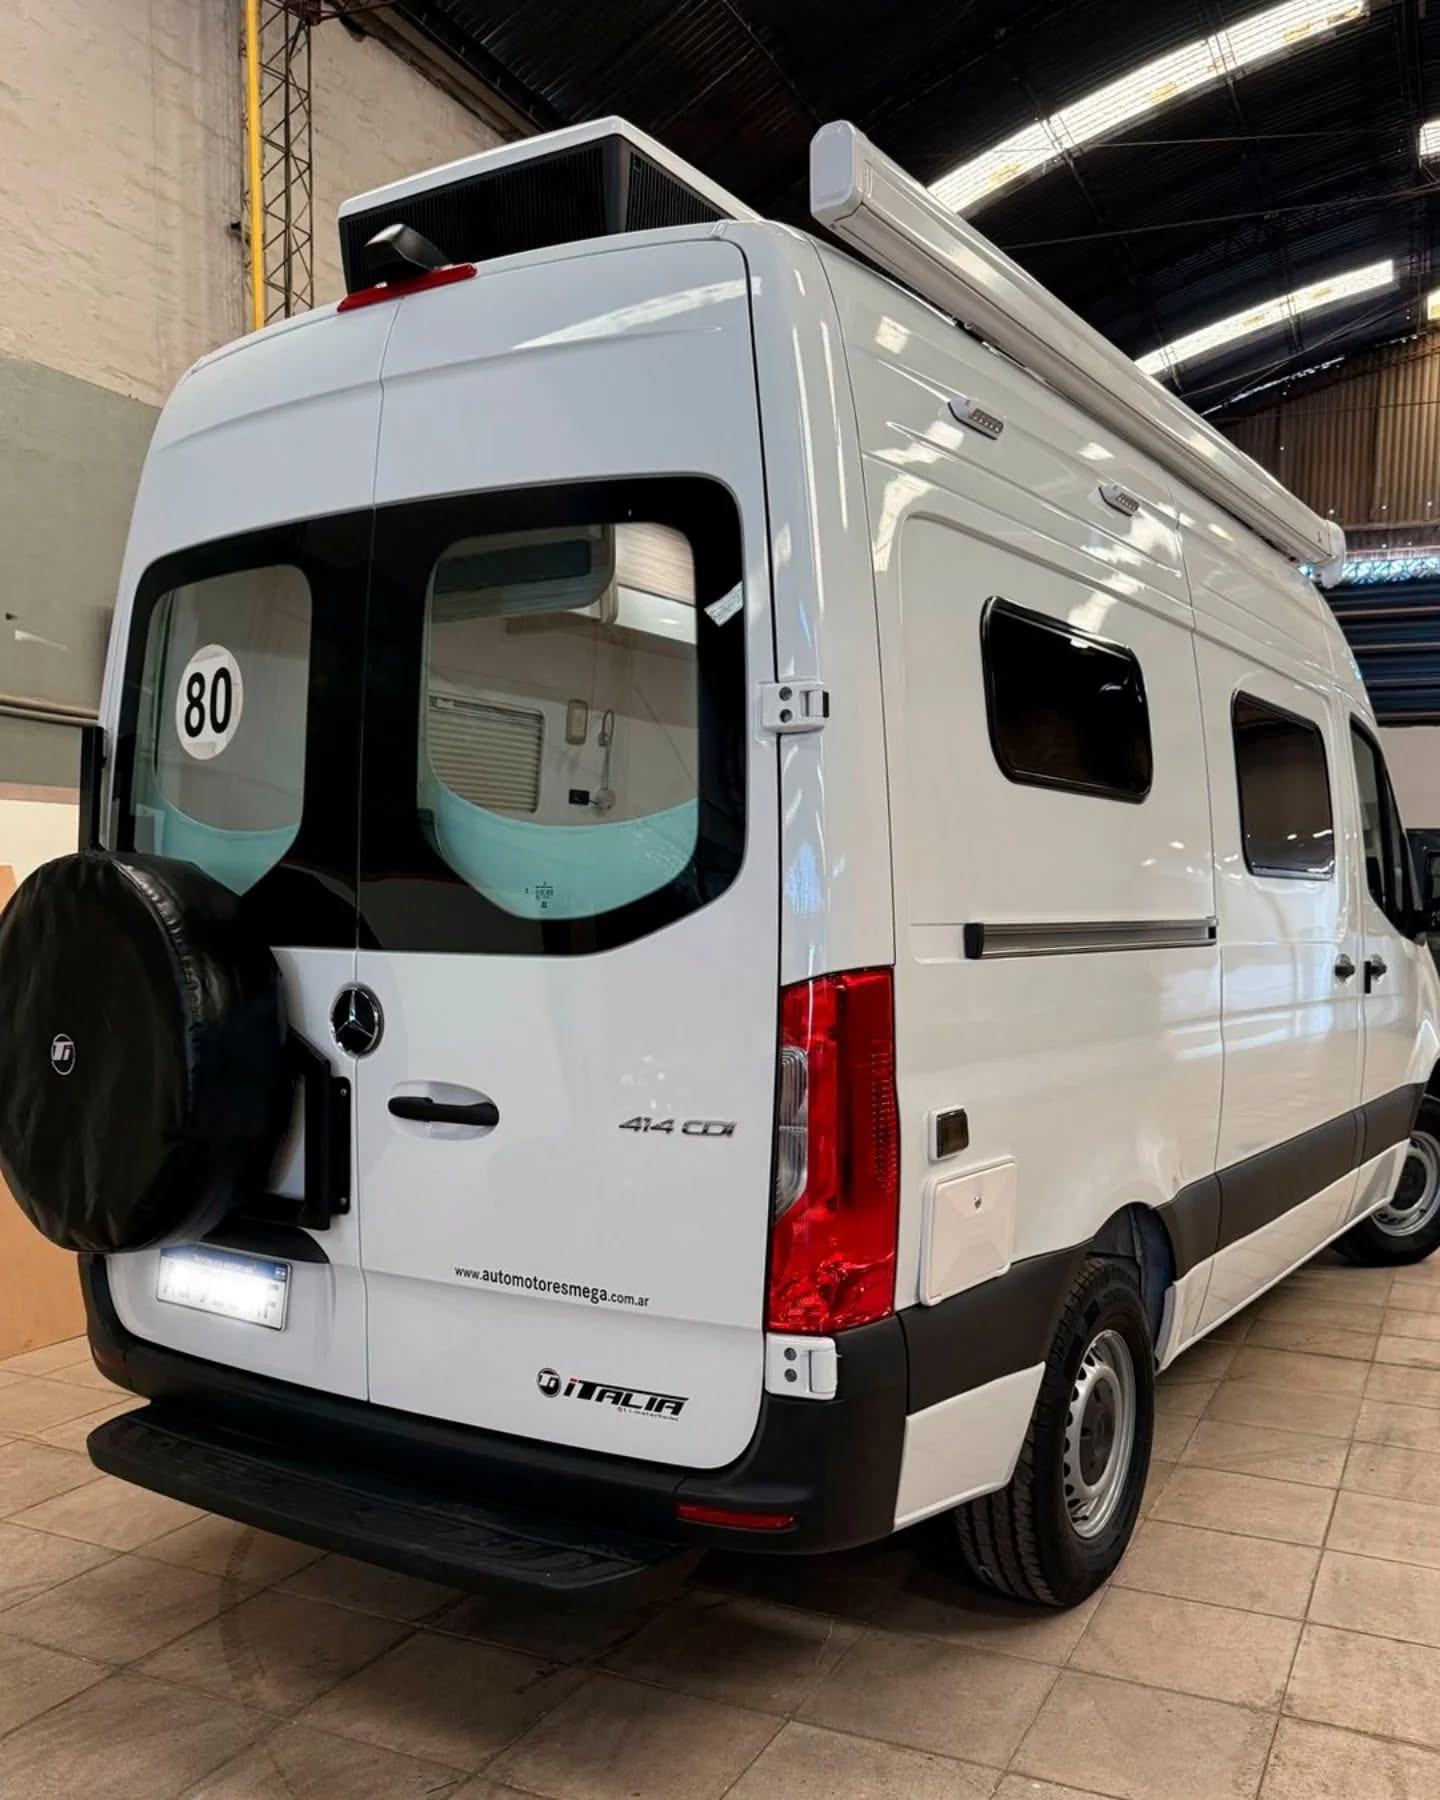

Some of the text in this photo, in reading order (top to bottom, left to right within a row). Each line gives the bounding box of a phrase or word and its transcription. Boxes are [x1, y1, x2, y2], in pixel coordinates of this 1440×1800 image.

[184, 666, 232, 738] 80
[618, 1117, 737, 1137] 414 CDI
[454, 1265, 650, 1306] www.automotoresmega.com.ar
